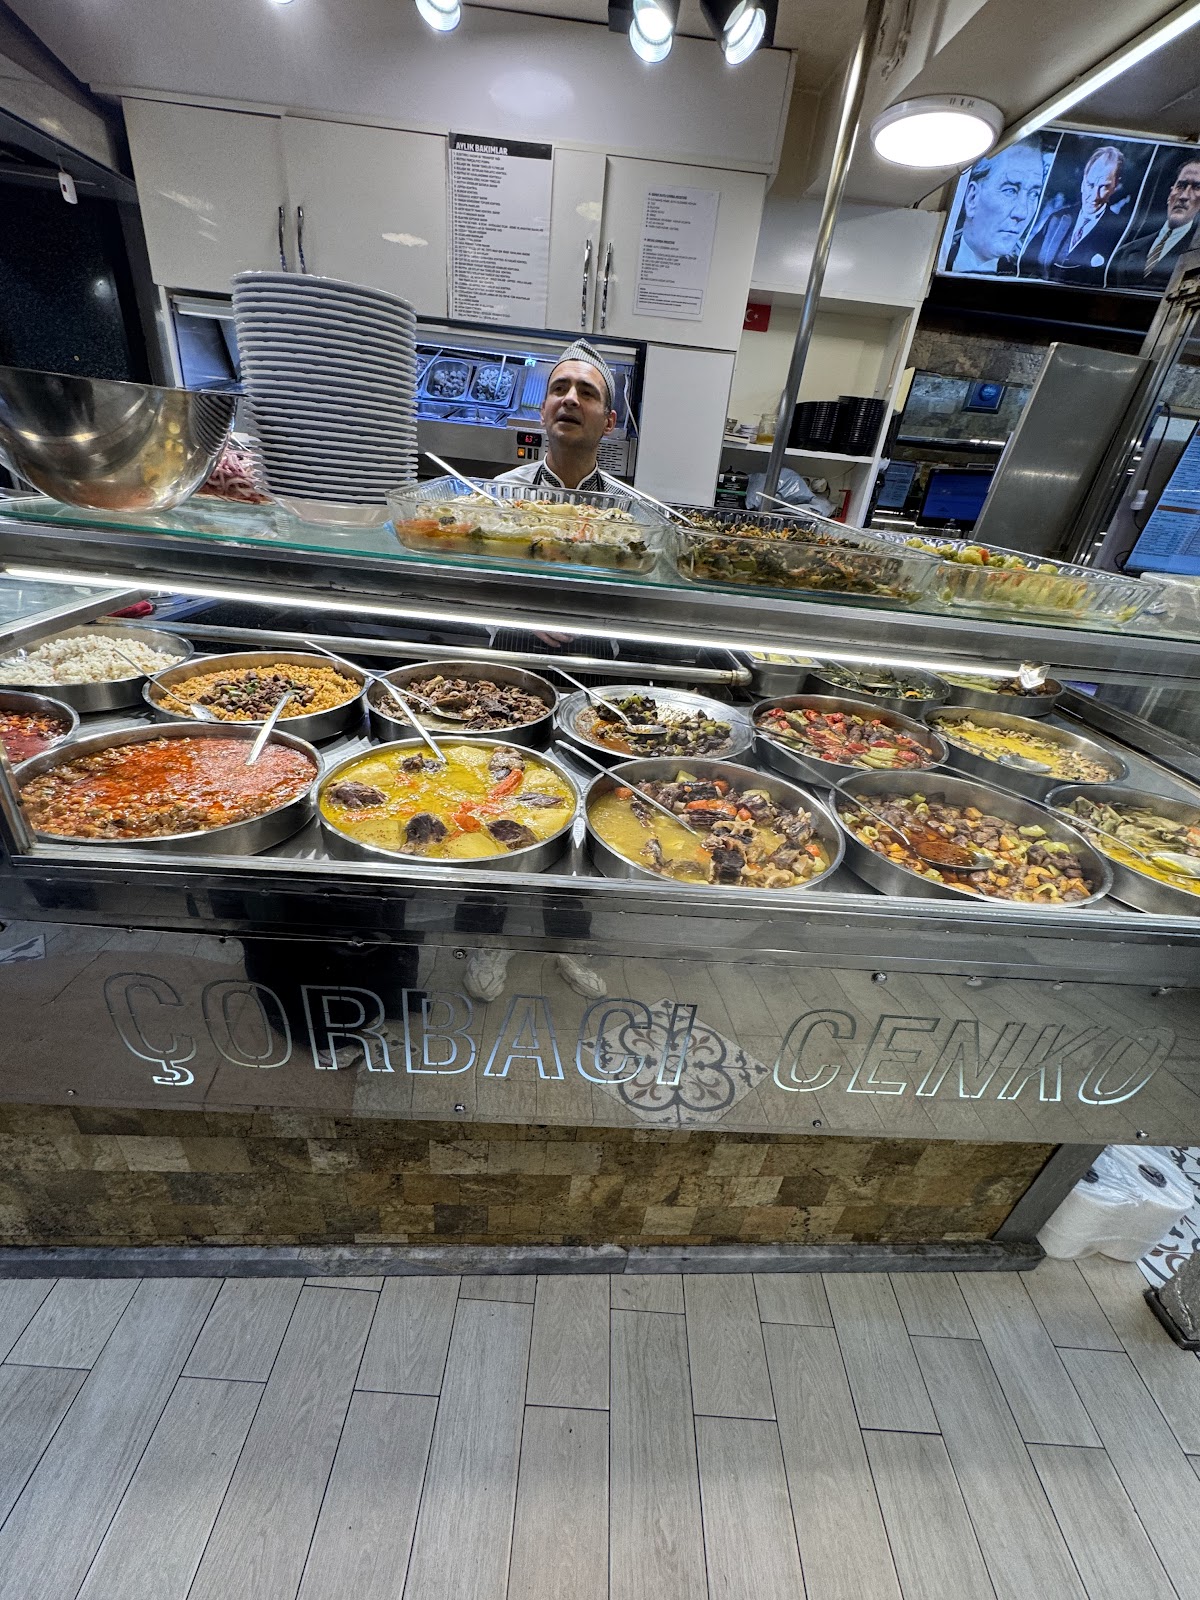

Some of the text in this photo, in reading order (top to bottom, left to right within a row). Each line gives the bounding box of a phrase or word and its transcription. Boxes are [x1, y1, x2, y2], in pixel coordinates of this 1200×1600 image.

[456, 142, 508, 155] AYLIK BAKIMLAR
[104, 972, 1177, 1105] ÇORBACI CENKO
